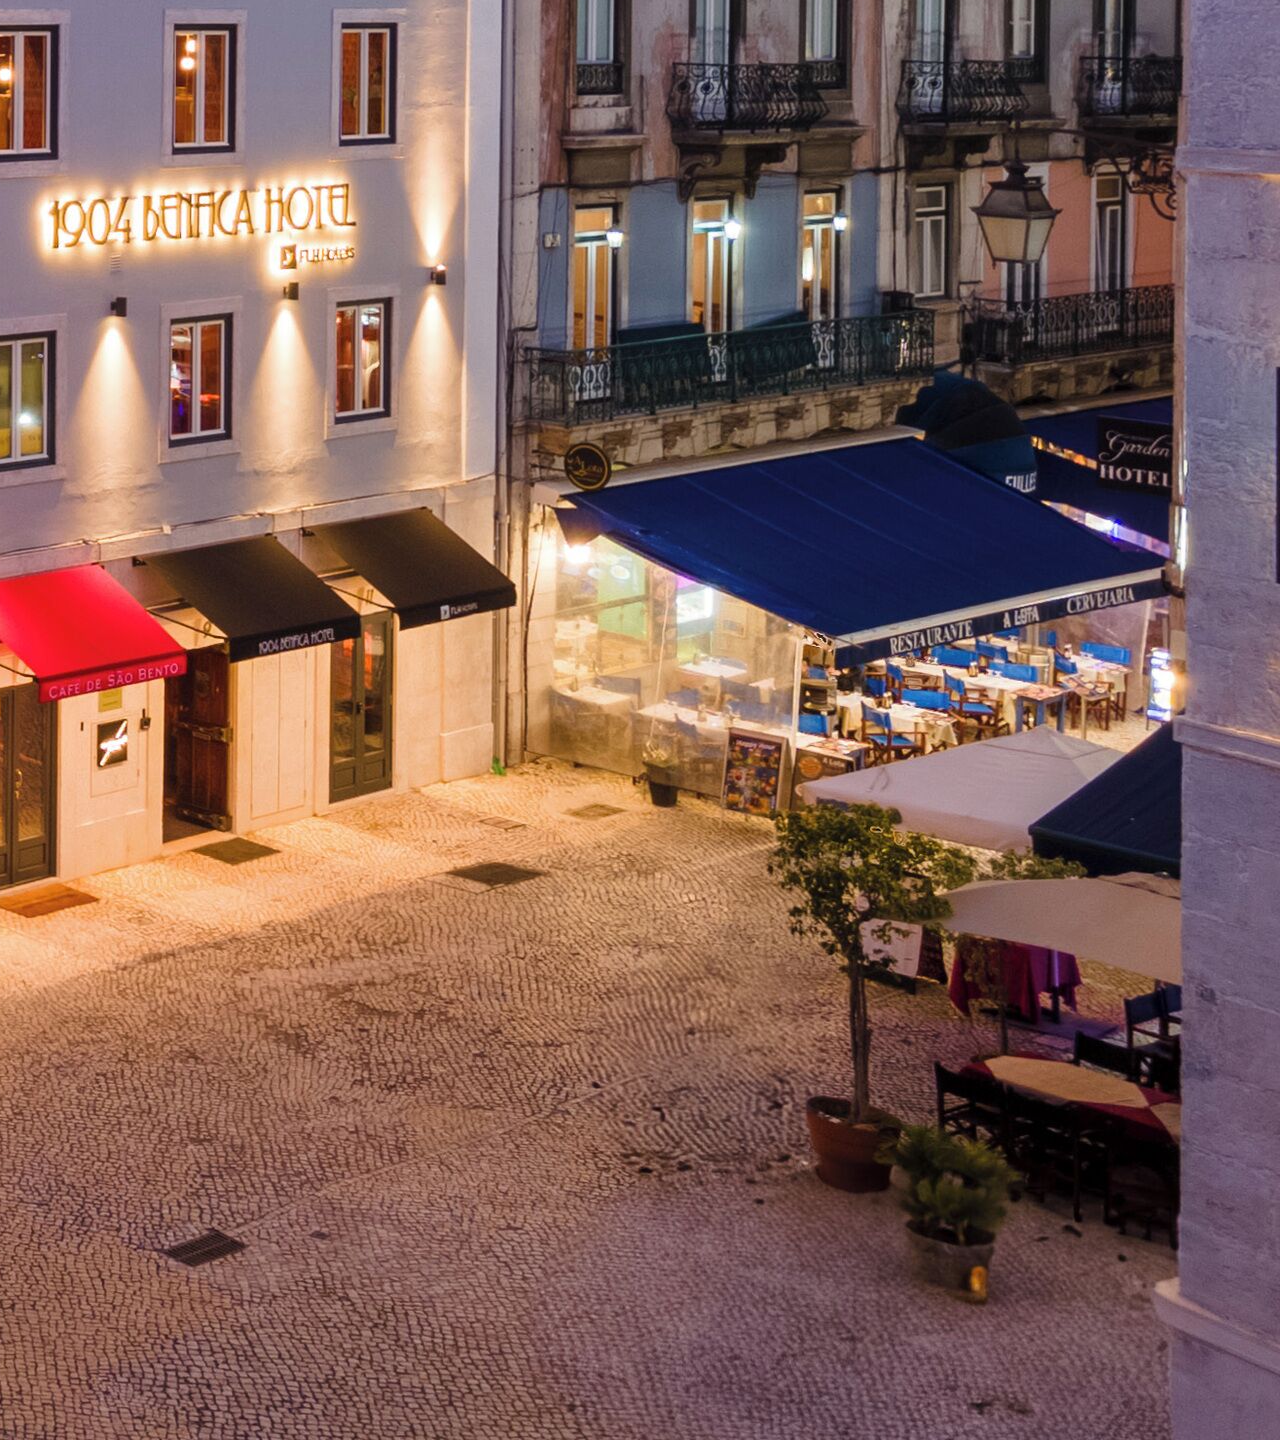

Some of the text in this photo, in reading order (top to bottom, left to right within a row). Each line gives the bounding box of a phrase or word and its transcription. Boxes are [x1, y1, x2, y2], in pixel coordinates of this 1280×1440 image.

[49, 183, 356, 248] 1904 BENFICA HOTEL
[1099, 430, 1172, 462] Garden
[1100, 464, 1173, 489] HOTEL
[890, 587, 1135, 655] RESTAURANTE A LOTA CERVEJARIA
[259, 639, 279, 655] 1904
[311, 628, 335, 644] HOTEL
[86, 679, 101, 692] DE
[138, 663, 179, 681] BENTO
